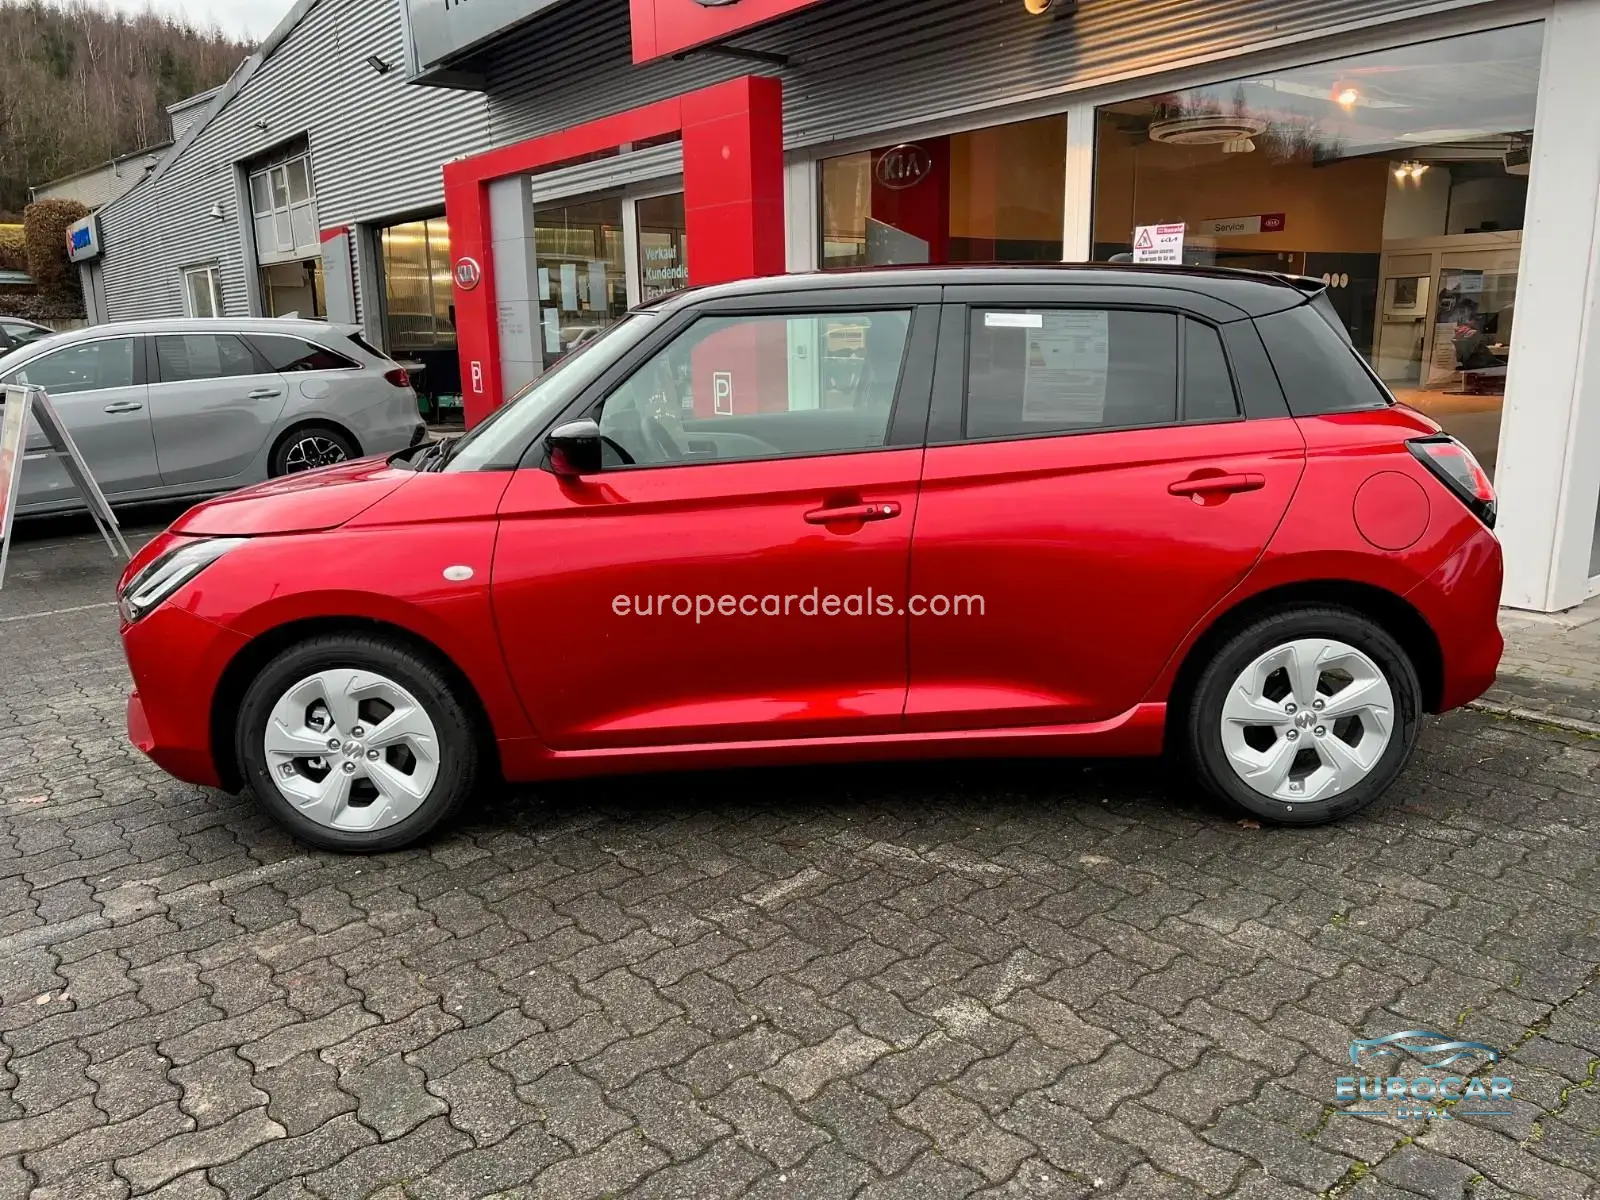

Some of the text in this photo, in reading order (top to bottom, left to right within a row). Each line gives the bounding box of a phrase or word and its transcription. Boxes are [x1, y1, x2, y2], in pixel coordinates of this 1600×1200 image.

[885, 153, 920, 180] KIA
[1215, 223, 1244, 232] Service
[646, 244, 677, 260] Verkauf
[646, 264, 689, 280] Kundendie
[716, 379, 729, 407] P
